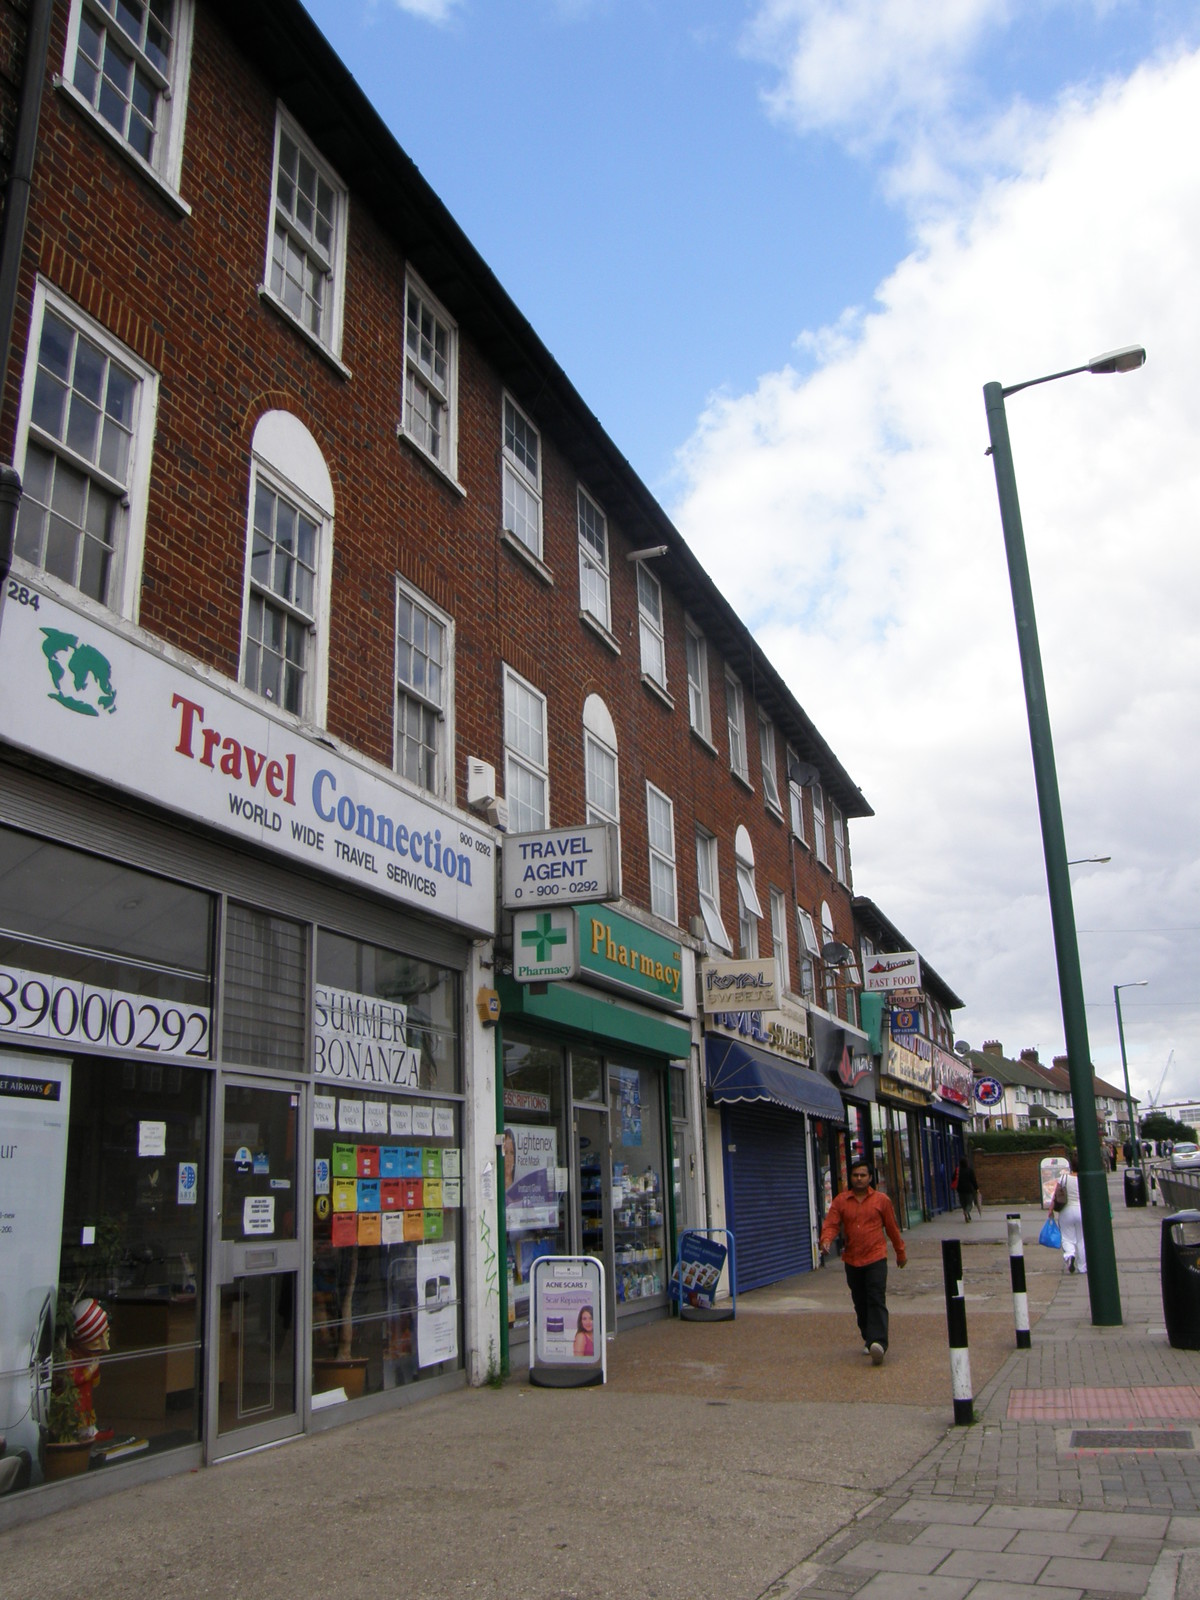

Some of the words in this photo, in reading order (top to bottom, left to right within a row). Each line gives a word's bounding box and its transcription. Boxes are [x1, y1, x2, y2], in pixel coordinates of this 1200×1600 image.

[8, 581, 40, 611] 284
[172, 693, 296, 806] Travel
[312, 769, 473, 887] Connection
[228, 793, 282, 832] WORLD
[291, 820, 325, 851] WIDE
[334, 840, 378, 874] TRAVEL
[386, 863, 437, 897] SERVICES
[459, 832, 473, 848] 900
[475, 840, 491, 857] 0292
[519, 837, 593, 860] TRAVEL
[523, 859, 587, 882] AGENT
[591, 918, 680, 993] Pharmacy
[518, 964, 571, 977] Pharmacy
[706, 970, 773, 991] ROYAL
[868, 978, 889, 988] FAST
[893, 976, 916, 986] FOOD
[708, 990, 774, 1004] SWEETS
[890, 995, 924, 1004] HOLSTEN
[315, 989, 407, 1045] SUMMER
[315, 1035, 419, 1088] BONANZA
[10, 1082, 43, 1092] AIRWAYS
[517, 1132, 553, 1155] Lightenex
[517, 1156, 528, 1166] Face
[528, 1156, 541, 1167] Mask
